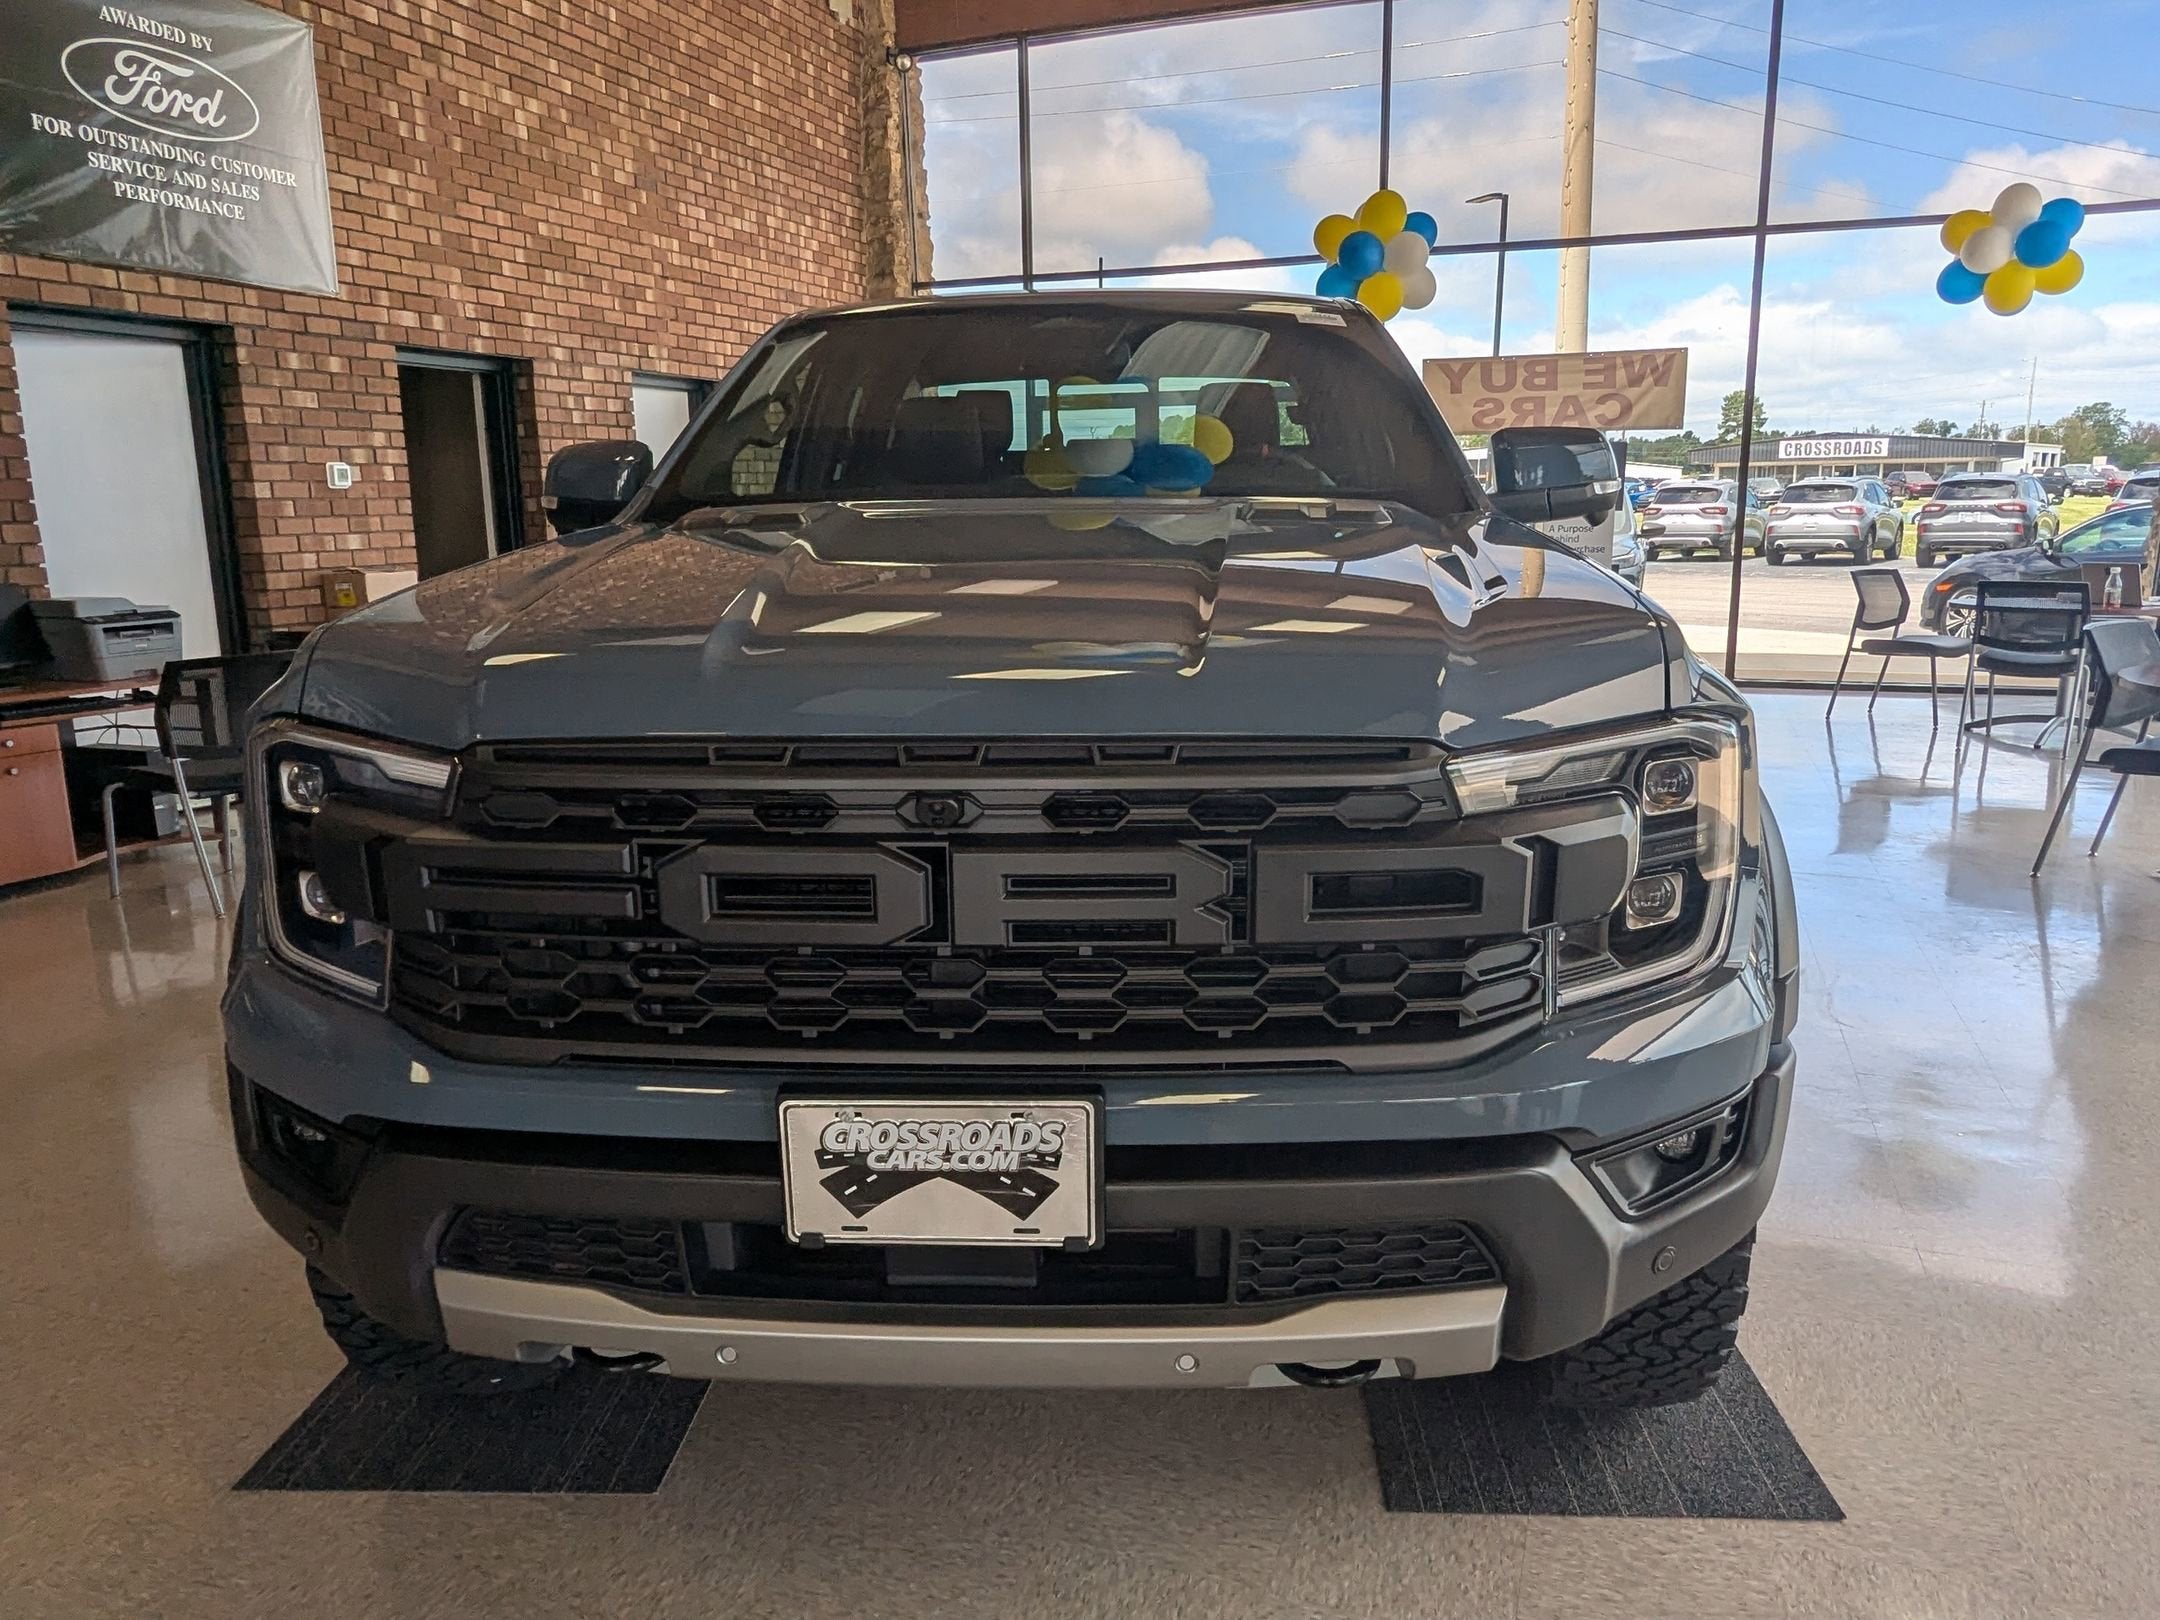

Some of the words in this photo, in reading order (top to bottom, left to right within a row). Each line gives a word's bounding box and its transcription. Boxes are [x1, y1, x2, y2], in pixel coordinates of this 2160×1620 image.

[99, 5, 186, 45] AWARDED
[190, 32, 213, 53] BY
[104, 50, 227, 128] Ford
[30, 112, 74, 138] FOR
[78, 124, 206, 168] OUTSTANDING
[210, 155, 298, 188] CUSTOMER
[87, 151, 167, 182] SERVICE
[172, 169, 207, 190] AND
[211, 178, 260, 202] SALES
[112, 180, 246, 220] PERFORMANCE
[1784, 440, 1883, 457] CROSSROADS
[1549, 524, 1556, 533] A
[1557, 524, 1594, 534] Purpose
[1551, 535, 1580, 543] ehind
[821, 1119, 1067, 1153] CROSSROADS
[866, 1149, 1021, 1172] CARS.COM
